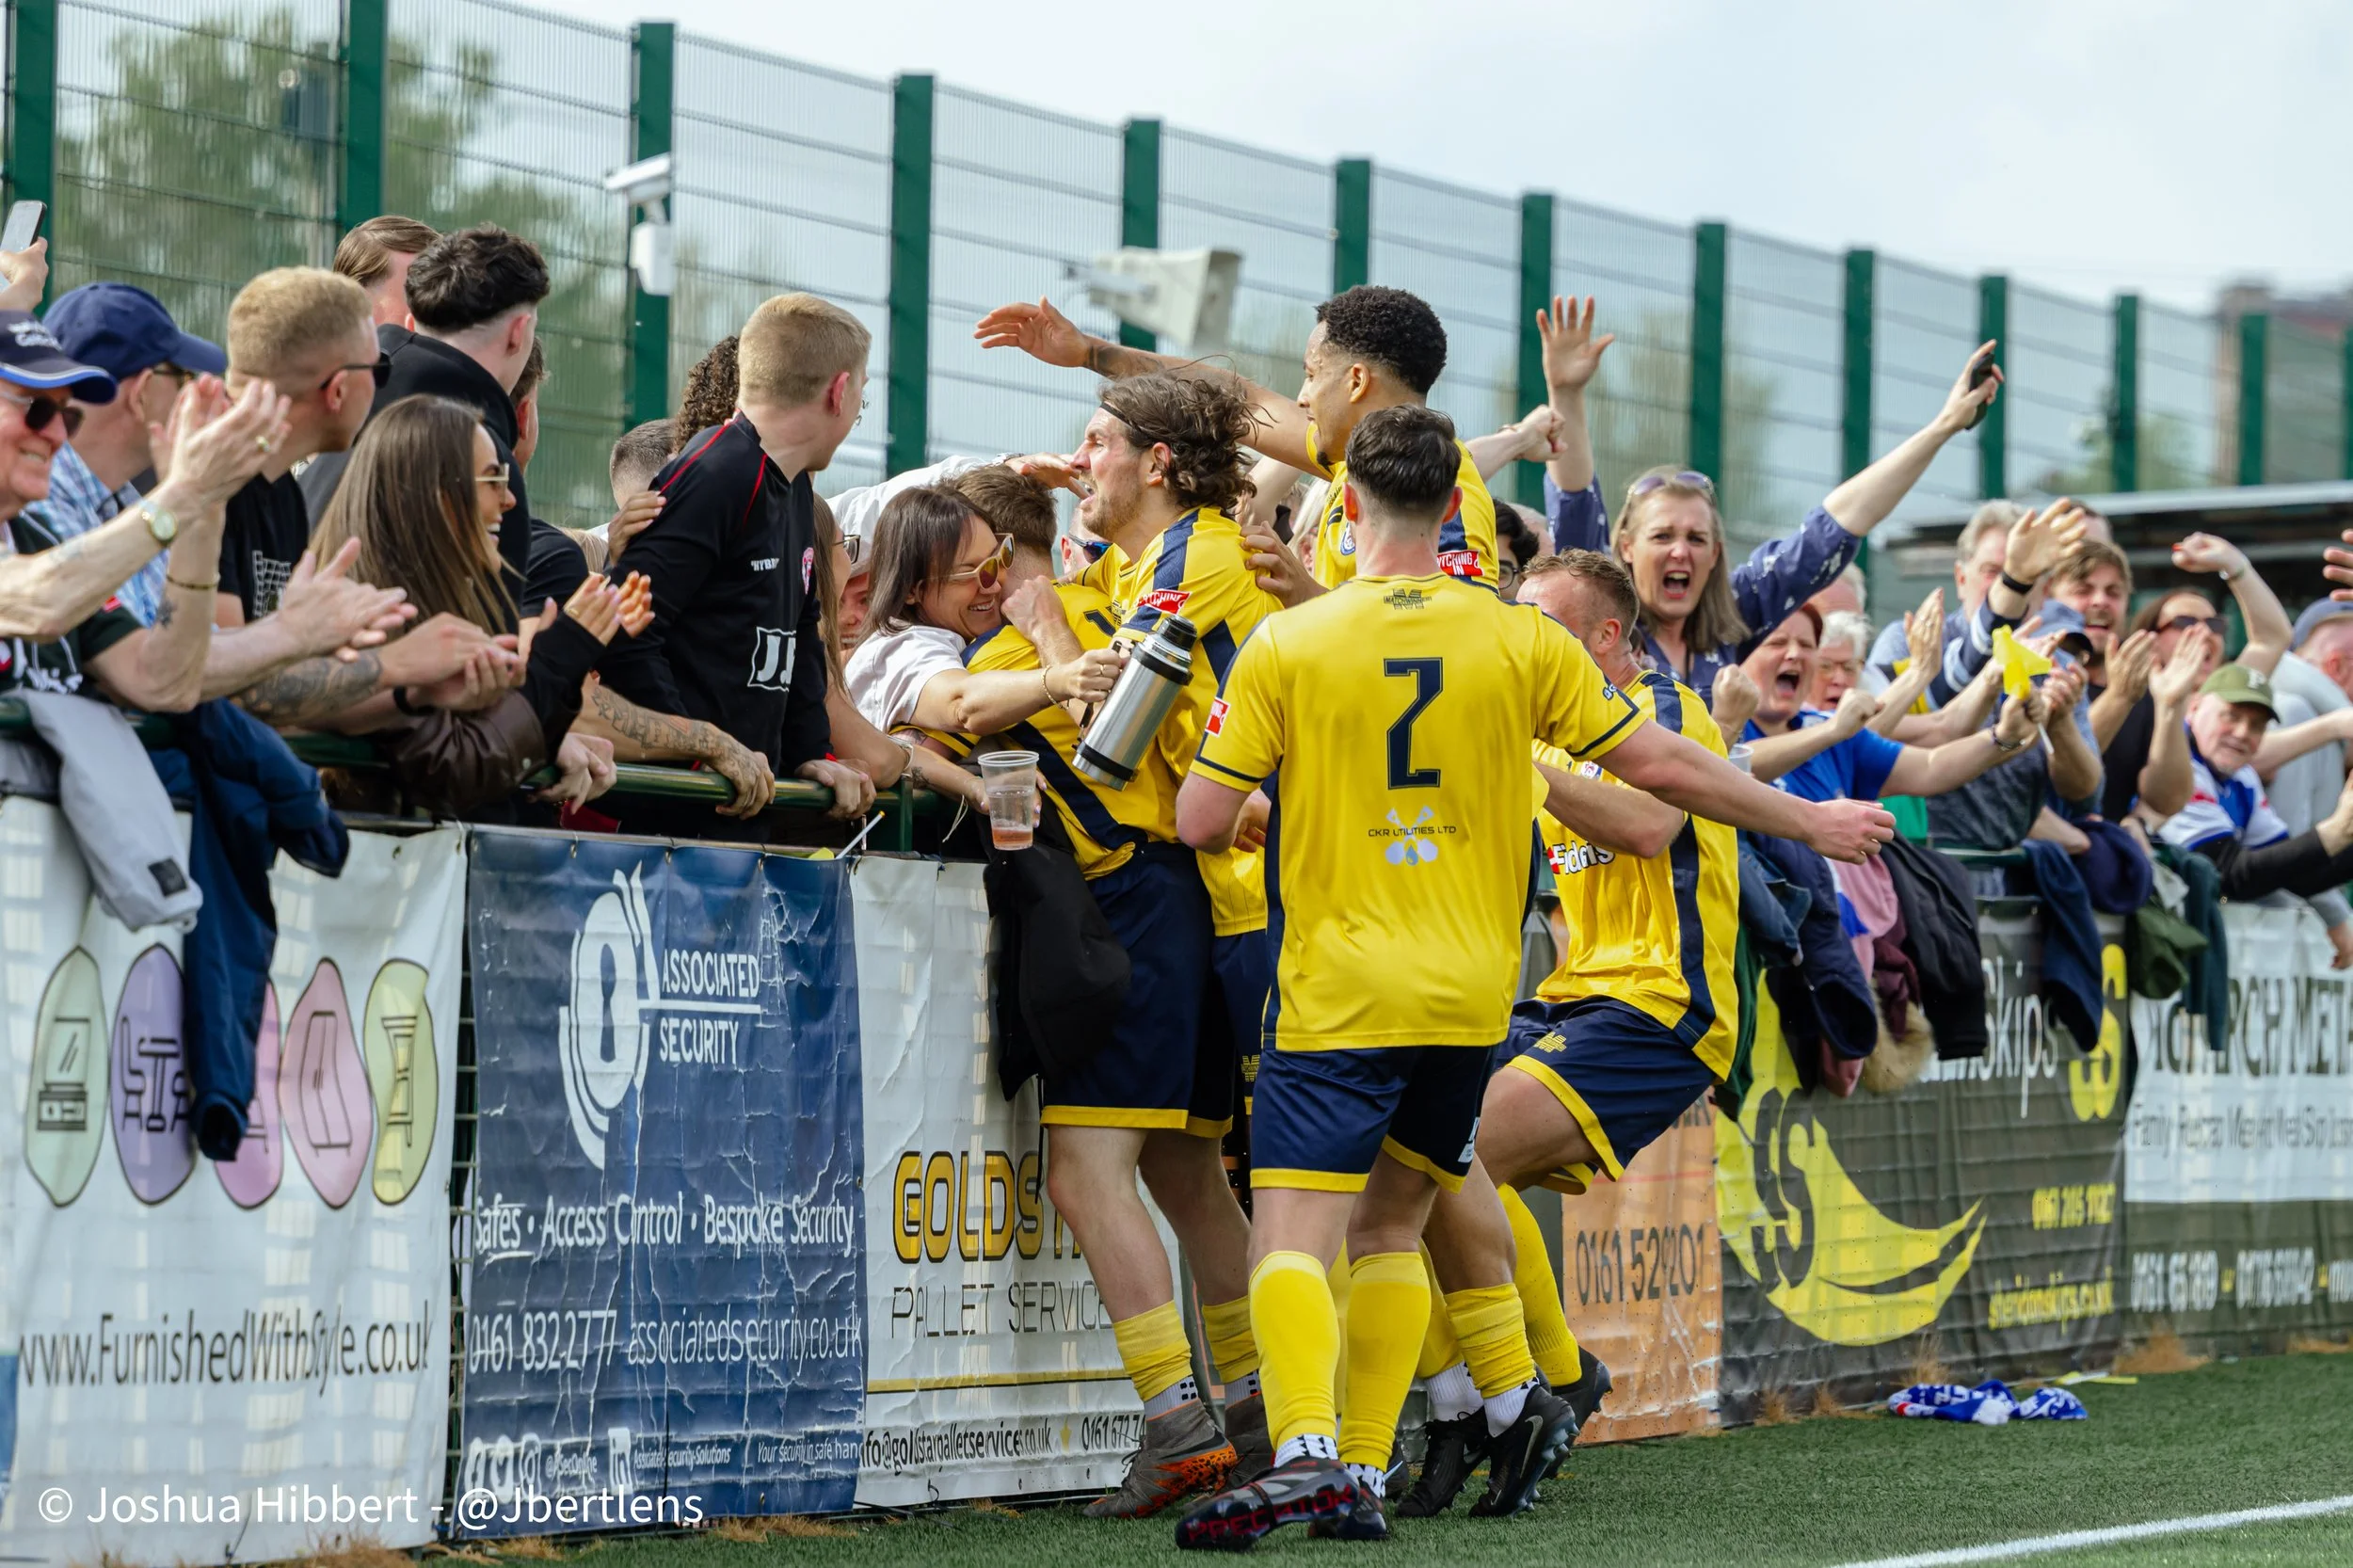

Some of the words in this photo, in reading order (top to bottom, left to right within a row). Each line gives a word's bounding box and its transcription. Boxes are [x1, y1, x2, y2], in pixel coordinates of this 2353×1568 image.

[1452, 565, 1465, 576] IN
[1384, 657, 1443, 791] 2
[1368, 828, 1390, 837] CKR
[1393, 825, 1435, 837] UTILITIES
[1437, 825, 1457, 835] LTD
[662, 949, 760, 999] ASSOCIATED
[659, 1016, 740, 1065] SECURITY
[540, 1195, 607, 1247] Access
[704, 1192, 784, 1259] Bespoke
[790, 1194, 855, 1258] Security
[1577, 1228, 1625, 1306] 0161
[892, 1283, 995, 1338] PALLET
[471, 1313, 514, 1374] 0161
[628, 1301, 864, 1377] associatedsecurity.co.uk
[758, 1442, 777, 1464] Your
[815, 1437, 832, 1460] safe
[1081, 1416, 1110, 1450] 0161
